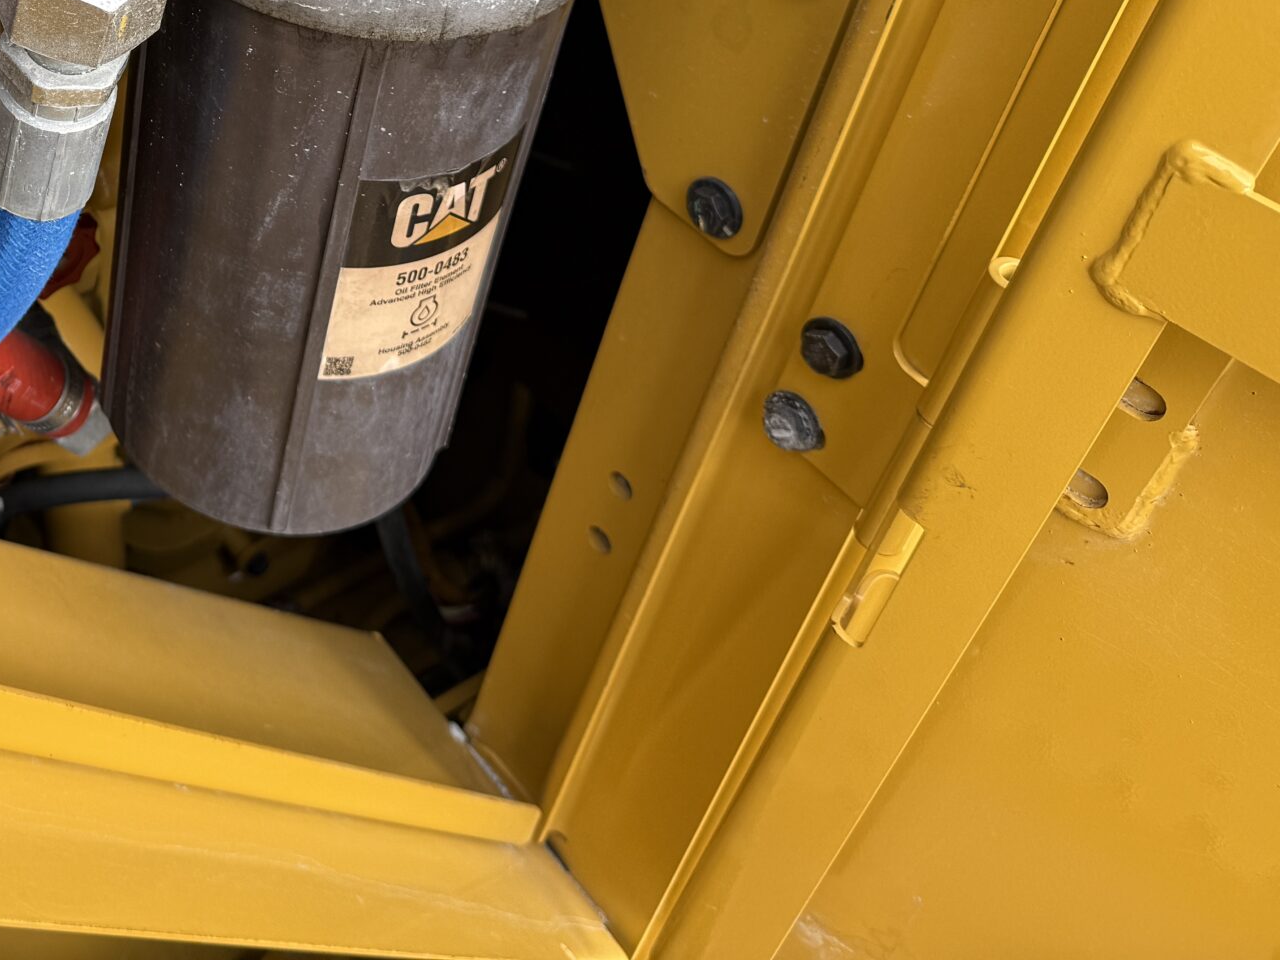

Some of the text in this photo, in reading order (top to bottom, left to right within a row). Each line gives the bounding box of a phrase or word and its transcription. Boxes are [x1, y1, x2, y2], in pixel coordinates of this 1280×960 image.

[391, 165, 498, 248] CAT
[396, 247, 469, 286] 500-0483
[369, 292, 416, 306] Advanced
[418, 285, 437, 297] High
[395, 287, 408, 296] Oil
[410, 280, 432, 292] Filter
[378, 341, 414, 355] Housing
